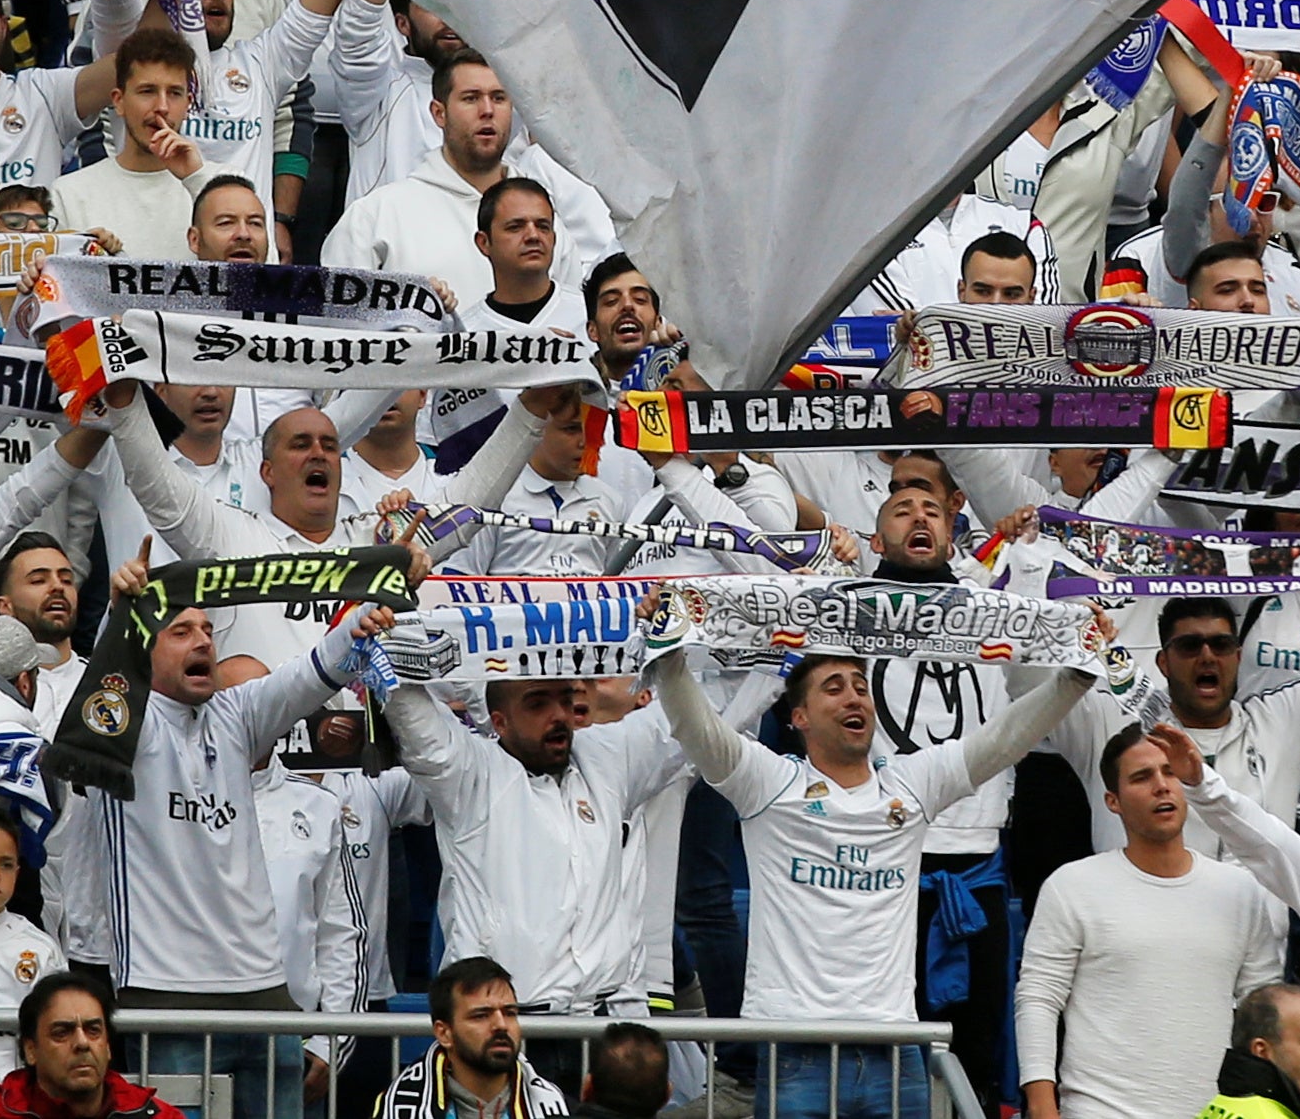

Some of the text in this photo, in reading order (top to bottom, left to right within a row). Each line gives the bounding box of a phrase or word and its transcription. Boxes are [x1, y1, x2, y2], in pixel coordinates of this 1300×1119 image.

[109, 263, 236, 297] REAL
[195, 324, 412, 371] Sangre
[948, 323, 1066, 361] REAL
[688, 399, 735, 434] LA
[1098, 581, 1134, 592] UN
[755, 587, 1037, 641] Real Madrid
[809, 631, 976, 654] Santiago Bernabeu
[835, 844, 869, 866] Fly
[791, 857, 905, 891] Emirates
